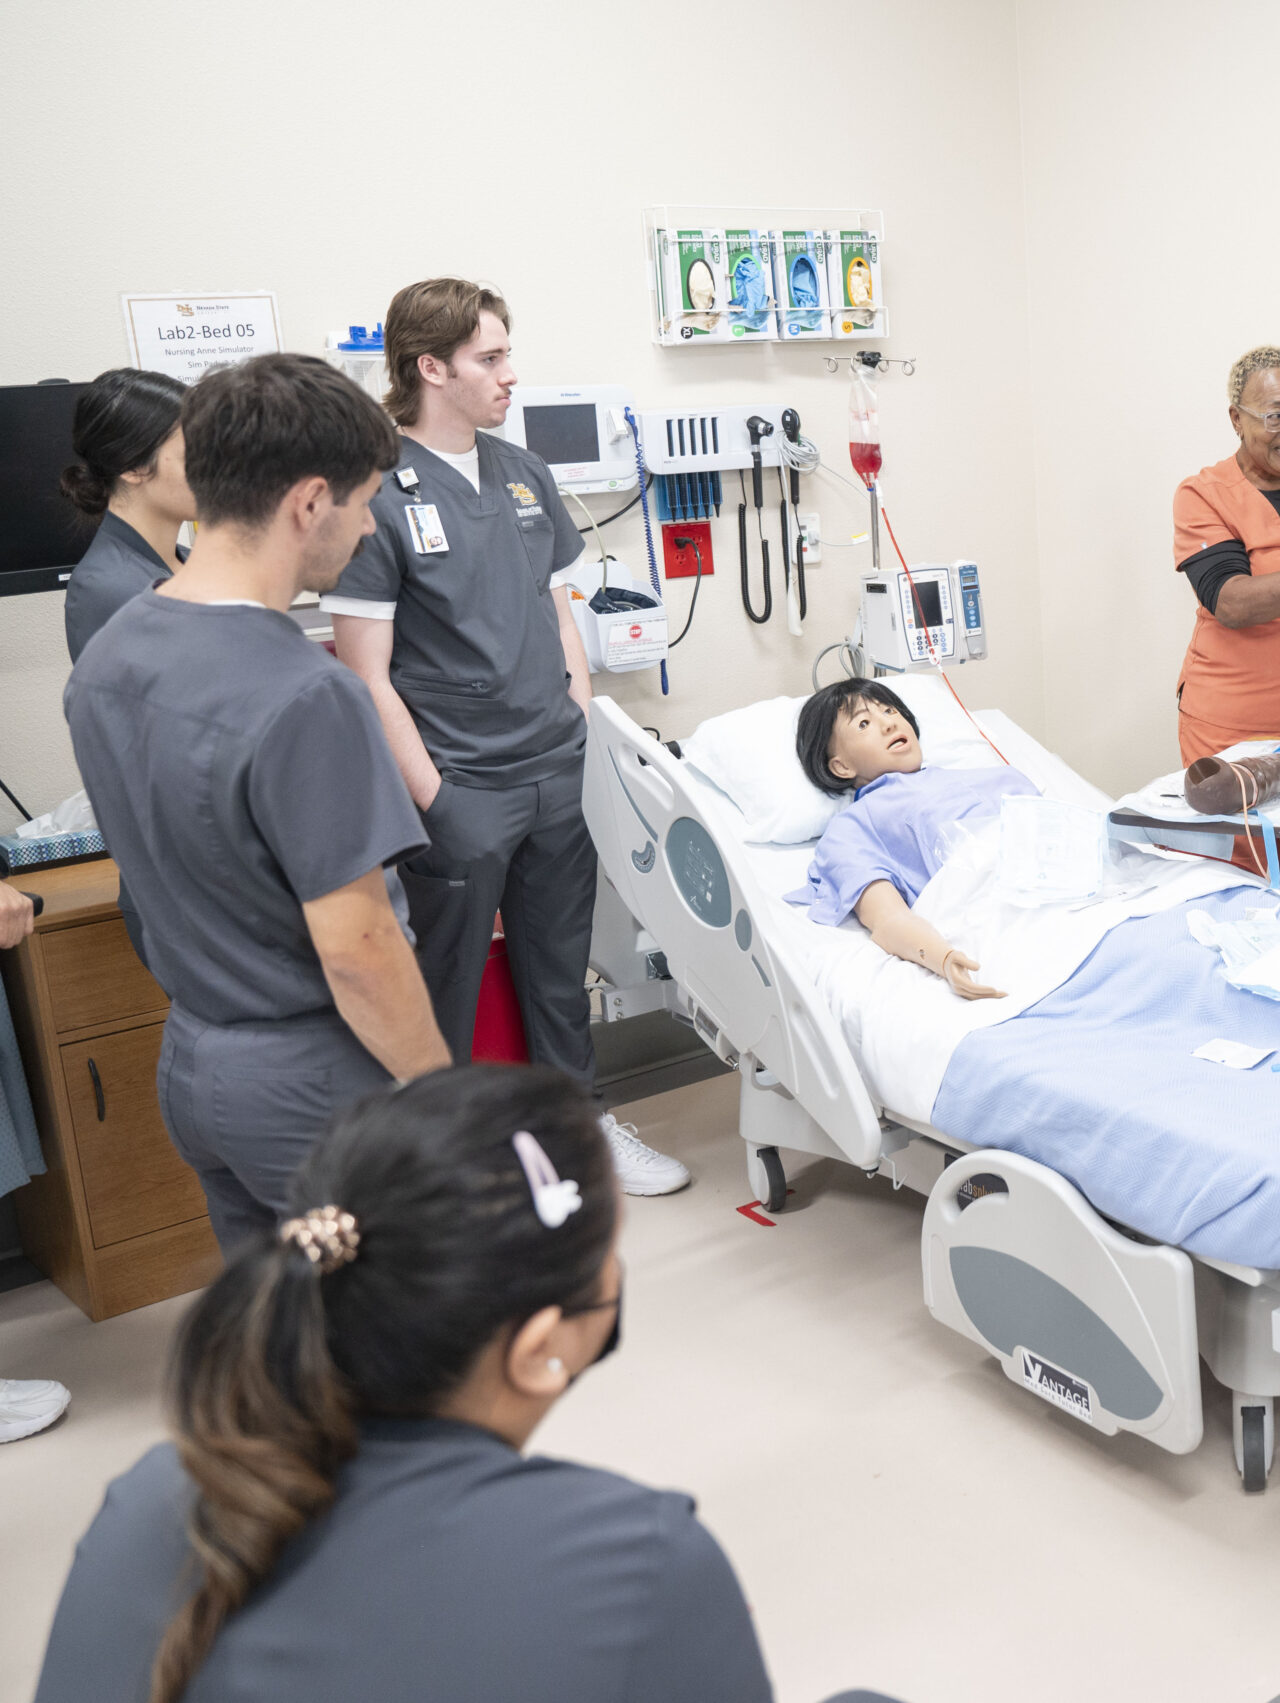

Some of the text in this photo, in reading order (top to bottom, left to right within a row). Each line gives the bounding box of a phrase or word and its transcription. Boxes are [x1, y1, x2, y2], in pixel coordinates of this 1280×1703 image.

[158, 323, 255, 340] Lab2-Bed 05
[683, 327, 691, 338] XL
[165, 348, 195, 357] Nursing
[218, 345, 254, 353] Simulator
[1023, 1350, 1088, 1409] VANTAGE
